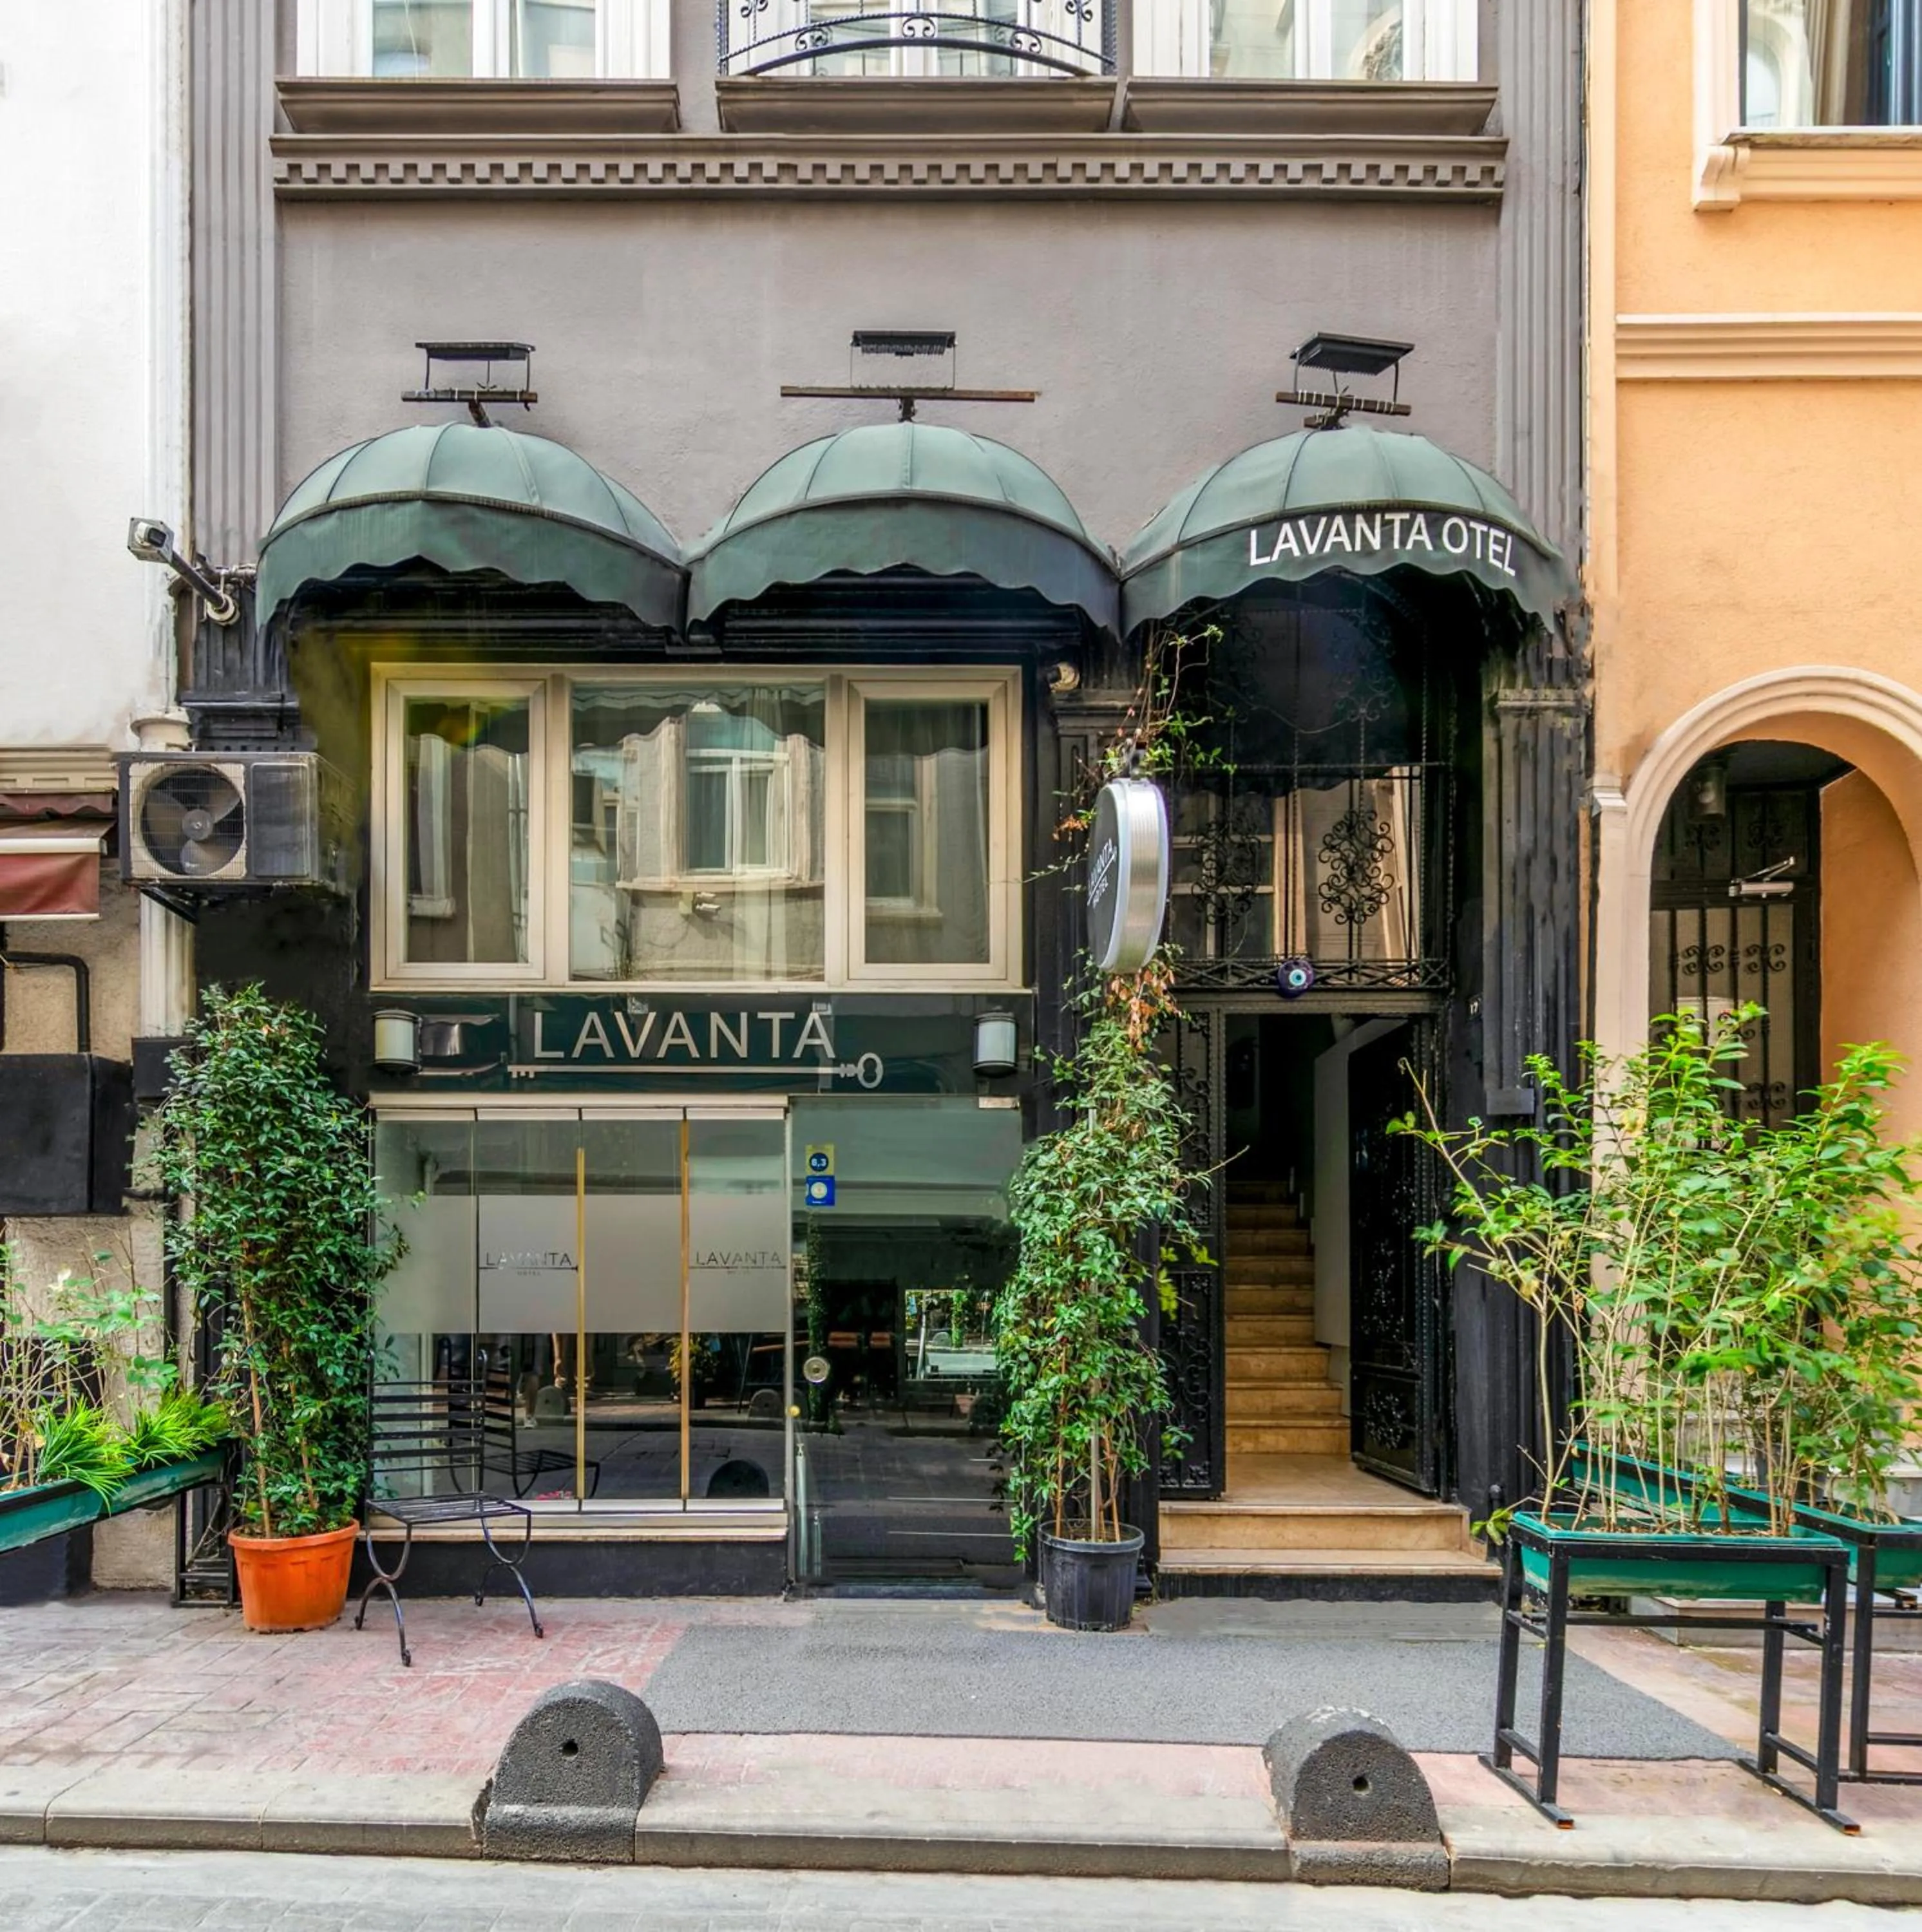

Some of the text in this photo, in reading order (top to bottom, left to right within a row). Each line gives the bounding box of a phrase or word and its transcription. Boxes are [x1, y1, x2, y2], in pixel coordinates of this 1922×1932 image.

[1250, 513, 1516, 576] LAVANTA OTEL
[533, 1012, 836, 1059] LAVANTA
[696, 1251, 782, 1265] LAVANTA
